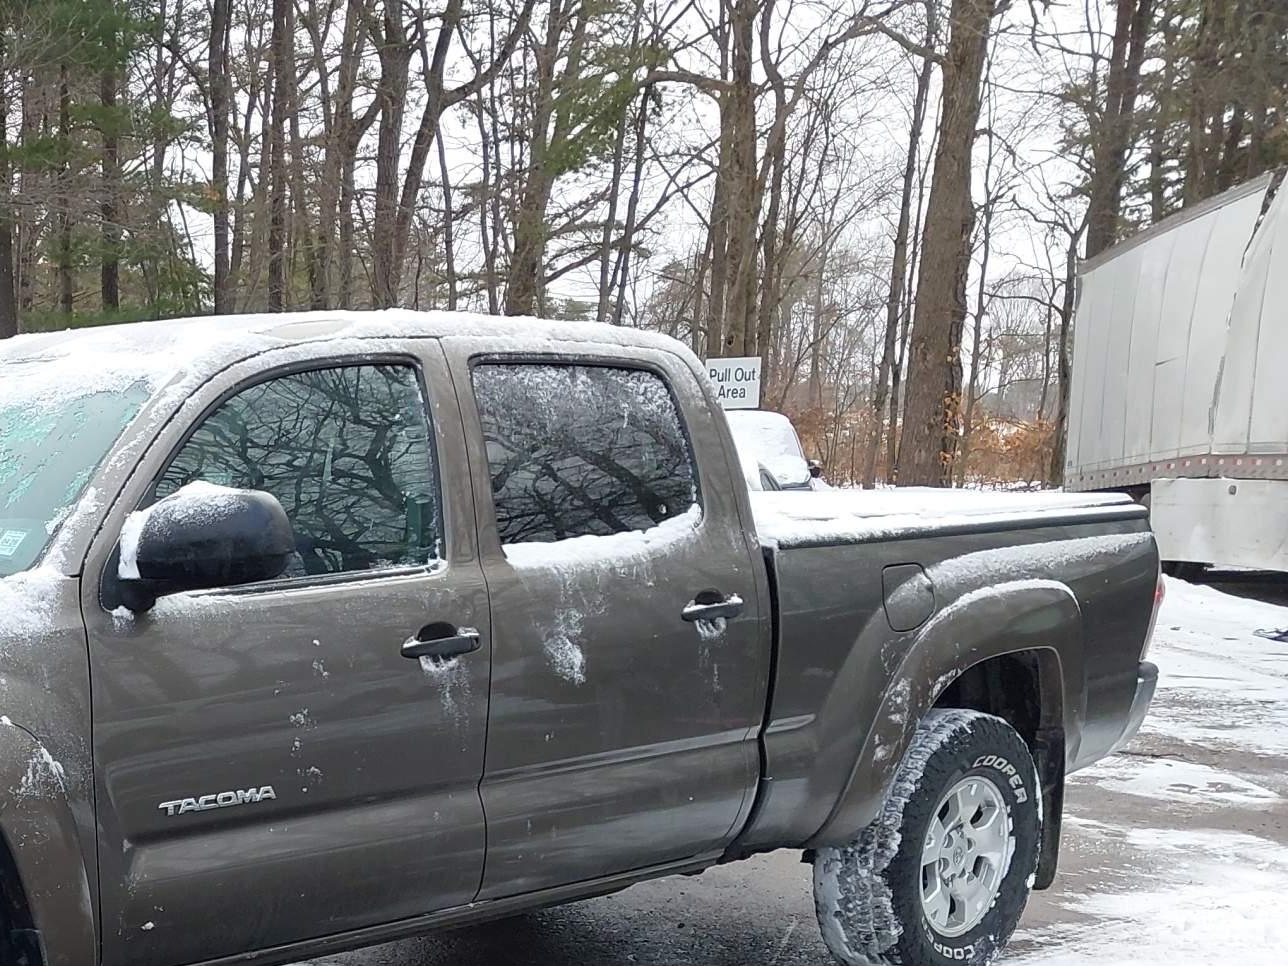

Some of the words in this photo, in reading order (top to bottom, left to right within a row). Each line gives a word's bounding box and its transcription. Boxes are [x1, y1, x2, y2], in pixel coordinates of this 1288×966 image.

[709, 367, 731, 382] Pull
[734, 367, 756, 382] Out
[718, 385, 746, 399] Area
[972, 755, 1028, 804] COOPER
[158, 785, 277, 816] TACOMA
